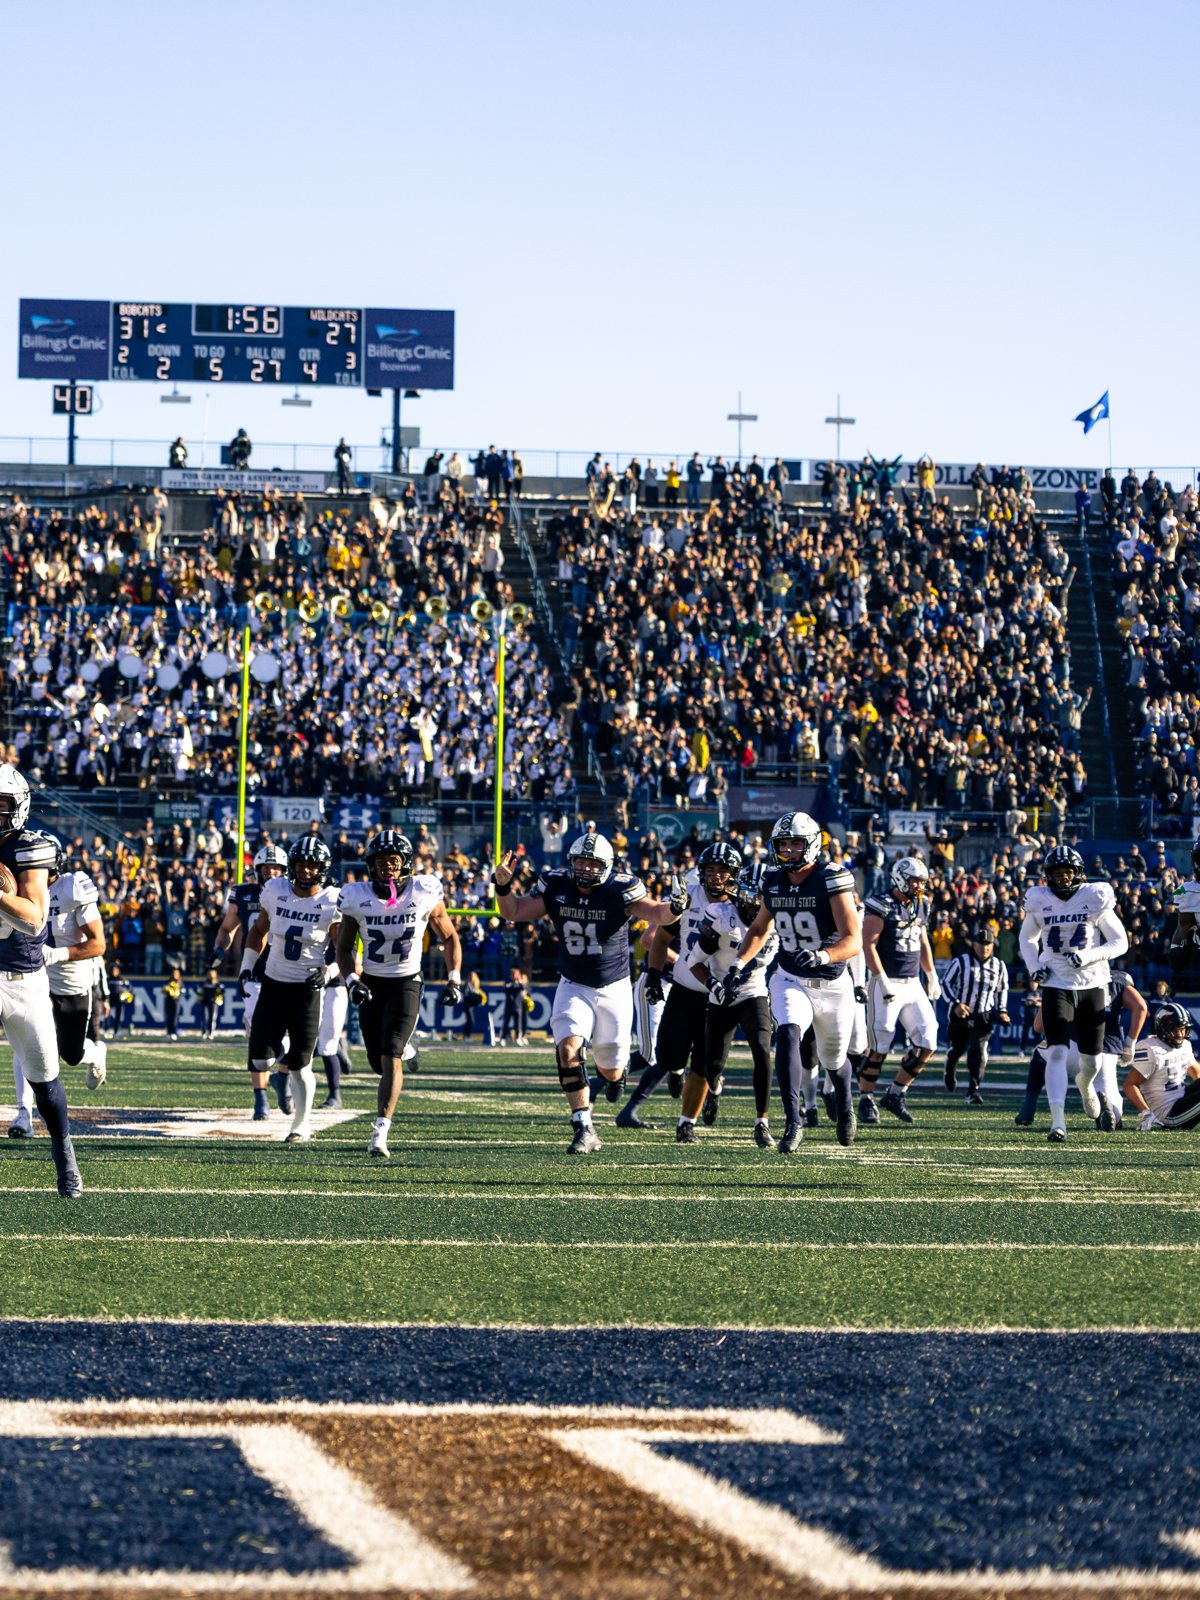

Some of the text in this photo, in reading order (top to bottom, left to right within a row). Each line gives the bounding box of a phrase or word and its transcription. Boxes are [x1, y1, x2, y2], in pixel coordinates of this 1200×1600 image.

[119, 304, 162, 317] BOBCATS
[227, 306, 279, 333] 1:56
[310, 309, 358, 322] WILDCATS
[120, 317, 149, 339] 31
[326, 322, 356, 345] 27
[22, 334, 106, 352] Billings Clinic
[147, 344, 181, 357] DOWN
[193, 345, 225, 358] TO GO
[34, 352, 76, 362] Bozeman
[118, 346, 129, 364] 2
[246, 346, 286, 360] BALL ON
[299, 348, 321, 361] QTR
[345, 351, 356, 370] 3
[367, 344, 451, 362] Billings Clinic
[156, 357, 171, 380] 2
[209, 358, 223, 381] 5
[250, 359, 281, 382] 27
[303, 362, 318, 382] 4
[380, 362, 422, 372] Bozeman
[55, 387, 91, 413] 40
[1033, 468, 1097, 489] ZONE
[282, 808, 311, 820] 120
[798, 896, 817, 907] STATE
[276, 906, 321, 923] WILDCATS
[365, 912, 417, 926] WILDCATS
[559, 906, 606, 921] MONTANA STATE
[1043, 913, 1088, 925] WILDCATS
[563, 921, 603, 955] 61
[775, 911, 822, 952] 99
[1047, 924, 1088, 953] 44
[284, 925, 304, 961] 6
[367, 927, 415, 963] 24
